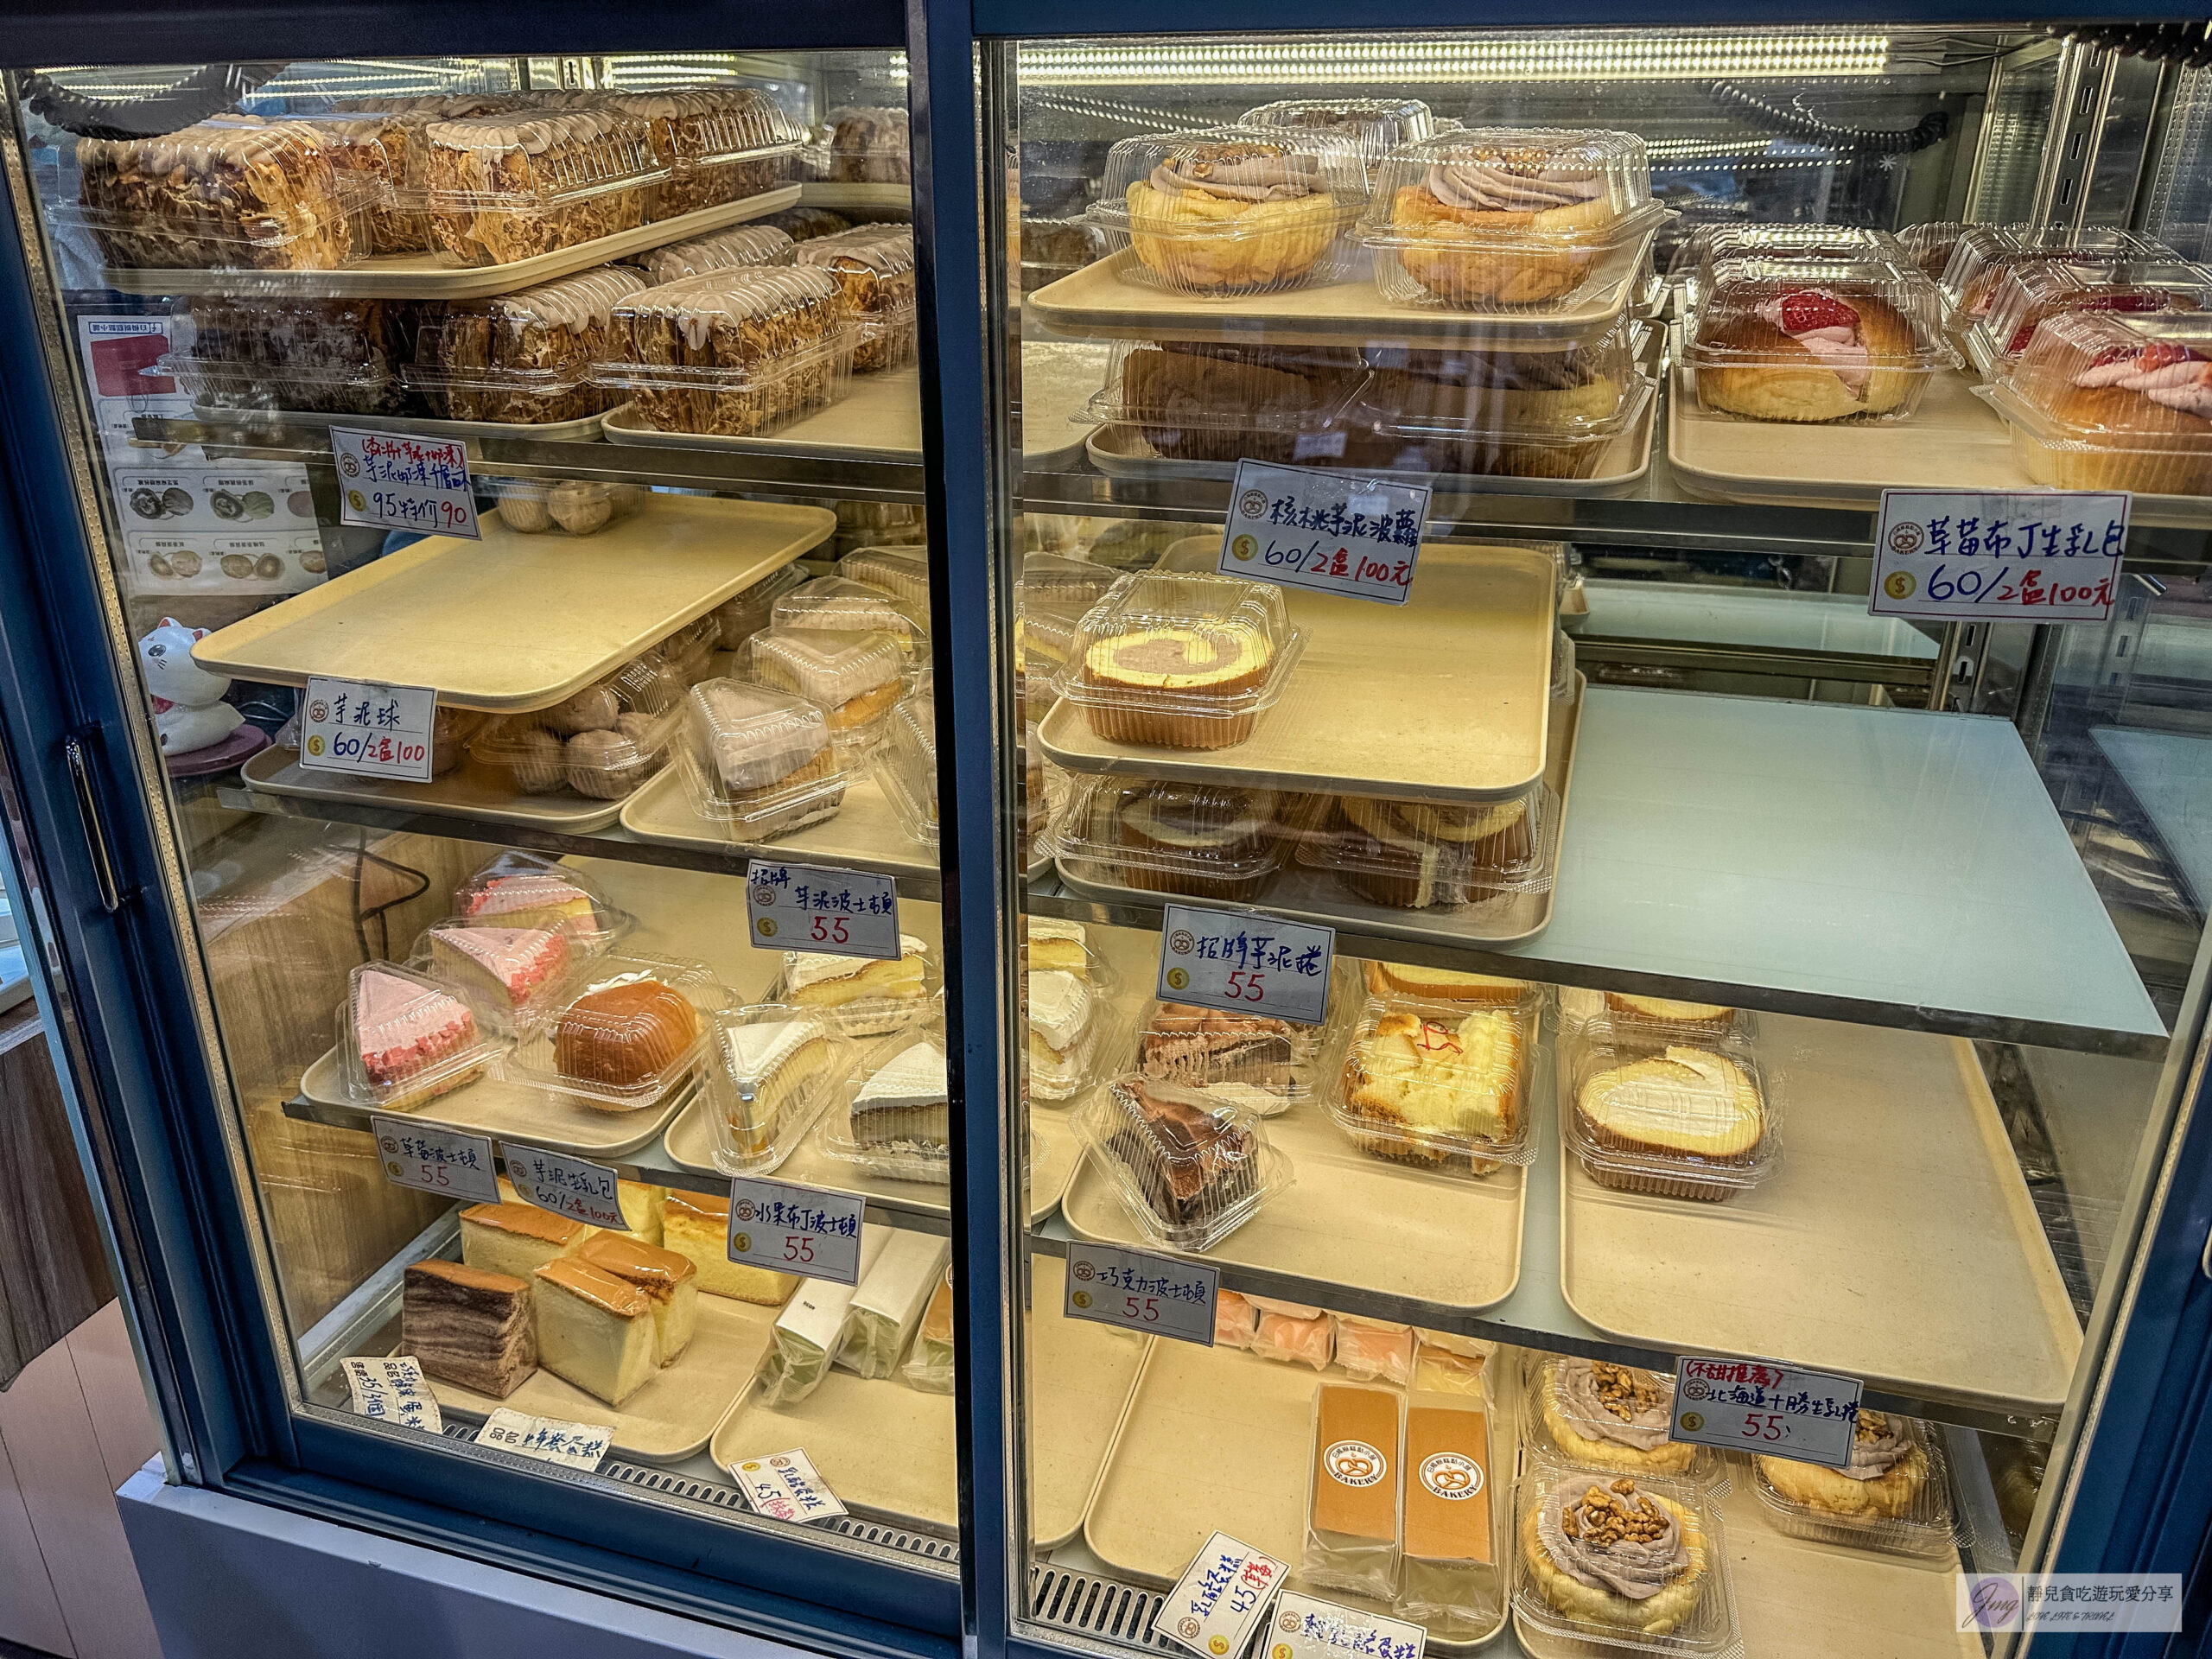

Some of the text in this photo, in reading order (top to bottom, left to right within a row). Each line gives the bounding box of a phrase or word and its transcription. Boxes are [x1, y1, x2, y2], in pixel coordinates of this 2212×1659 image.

[334, 692, 401, 733] 芋泥球
[795, 885, 893, 916] 芋泥波士頓
[810, 916, 850, 944] 55
[1224, 970, 1266, 1003] 55
[420, 1164, 450, 1187] 55
[783, 1236, 815, 1263] 55
[1096, 1266, 1207, 1306] 巧克力波士頓
[1122, 1297, 1160, 1322] 55
[489, 1427, 520, 1445] 品名
[1740, 1412, 1784, 1441] 55
[754, 1483, 782, 1500] 45
[1333, 1471, 1379, 1486] BAKERY
[1431, 1484, 1478, 1500] BAKERY
[1230, 1585, 1257, 1613] 45
